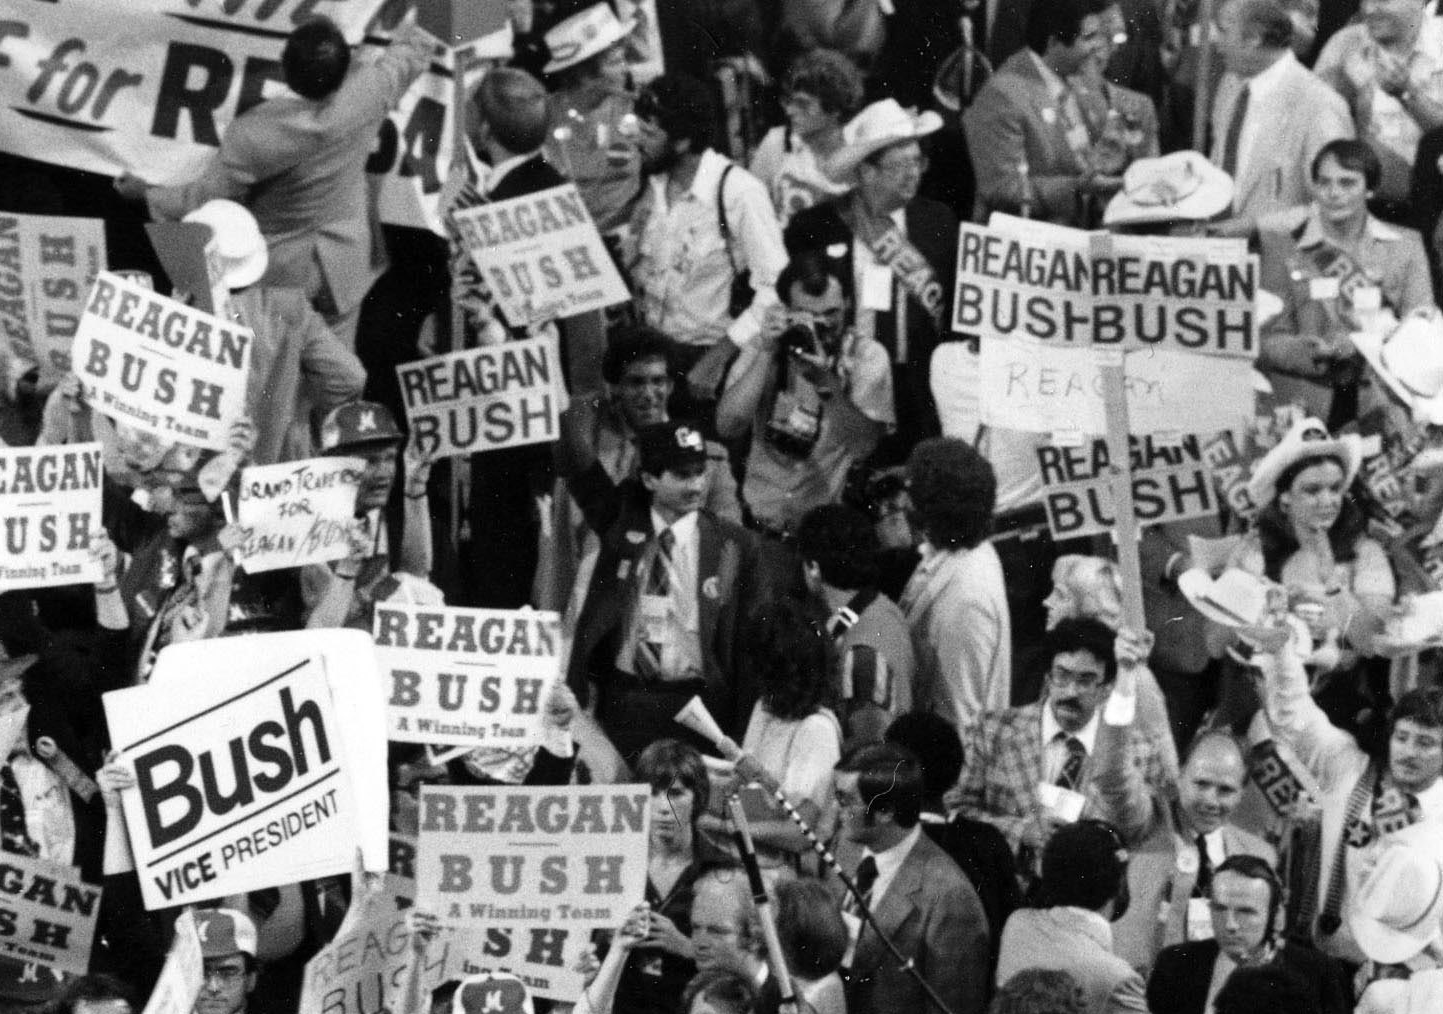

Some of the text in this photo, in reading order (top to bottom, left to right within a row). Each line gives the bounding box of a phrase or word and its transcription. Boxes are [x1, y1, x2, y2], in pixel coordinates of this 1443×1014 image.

[27, 37, 144, 119] for
[457, 192, 586, 248] REAGAN
[489, 247, 600, 299] BUSH
[960, 231, 1090, 293] REAGAN
[1090, 256, 1254, 300] REAGAN
[87, 279, 250, 369] REAGAN
[1092, 304, 1253, 350] BUSH
[85, 340, 224, 420] BUSH
[401, 347, 550, 406] REAGAN
[413, 396, 554, 453] BUSH
[374, 609, 560, 657] REAGAN
[389, 669, 543, 714] BUSH
[396, 717, 527, 738] A Winning Team
[133, 686, 333, 849] Bush
[422, 794, 648, 834] REAGAN
[154, 852, 218, 900] VICE
[221, 789, 340, 870] PRESIDENT
[438, 854, 624, 894] BUSH
[449, 903, 611, 922] A Winning Team
